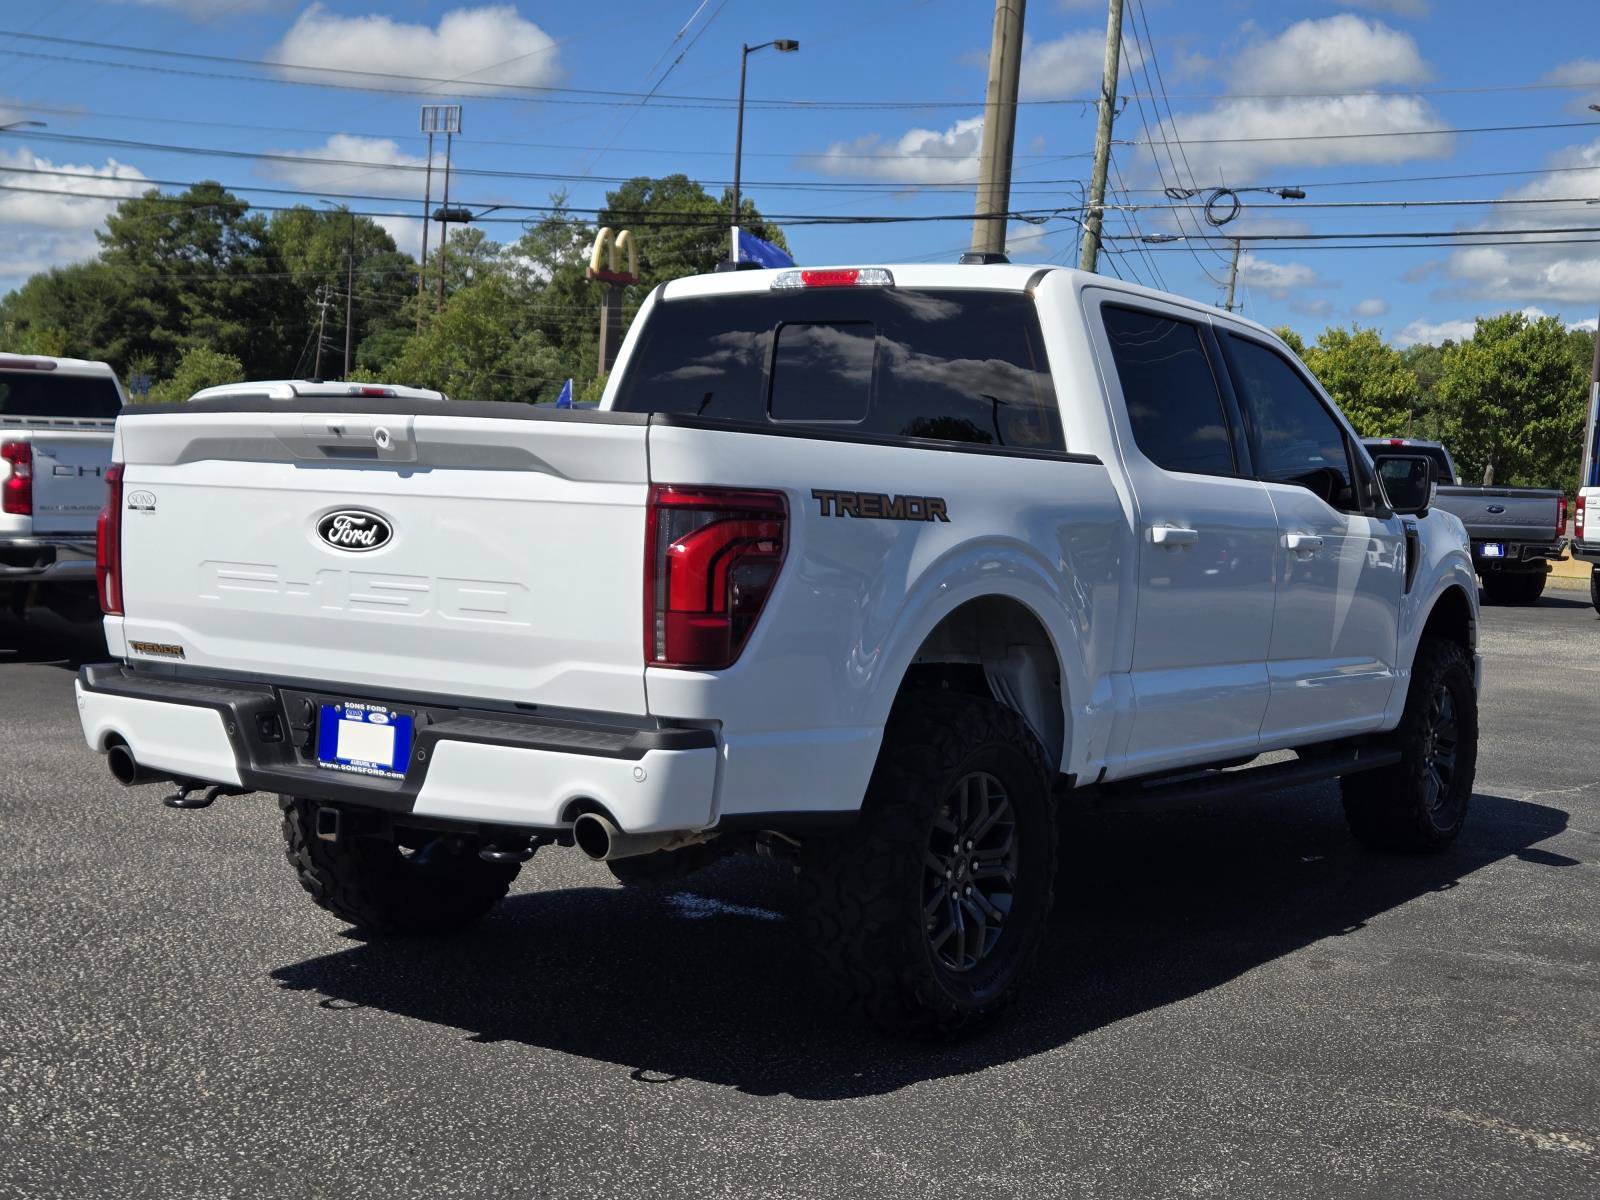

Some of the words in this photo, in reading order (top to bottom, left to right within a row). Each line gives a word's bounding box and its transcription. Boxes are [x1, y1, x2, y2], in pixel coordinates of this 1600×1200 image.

[53, 465, 107, 477] CH
[811, 488, 951, 523] TREMOR
[328, 515, 378, 545] Ford
[128, 640, 186, 660] TREMOR
[344, 702, 365, 710] SONS
[367, 704, 387, 713] FORD
[320, 762, 405, 779] www.SONSFORD.com
